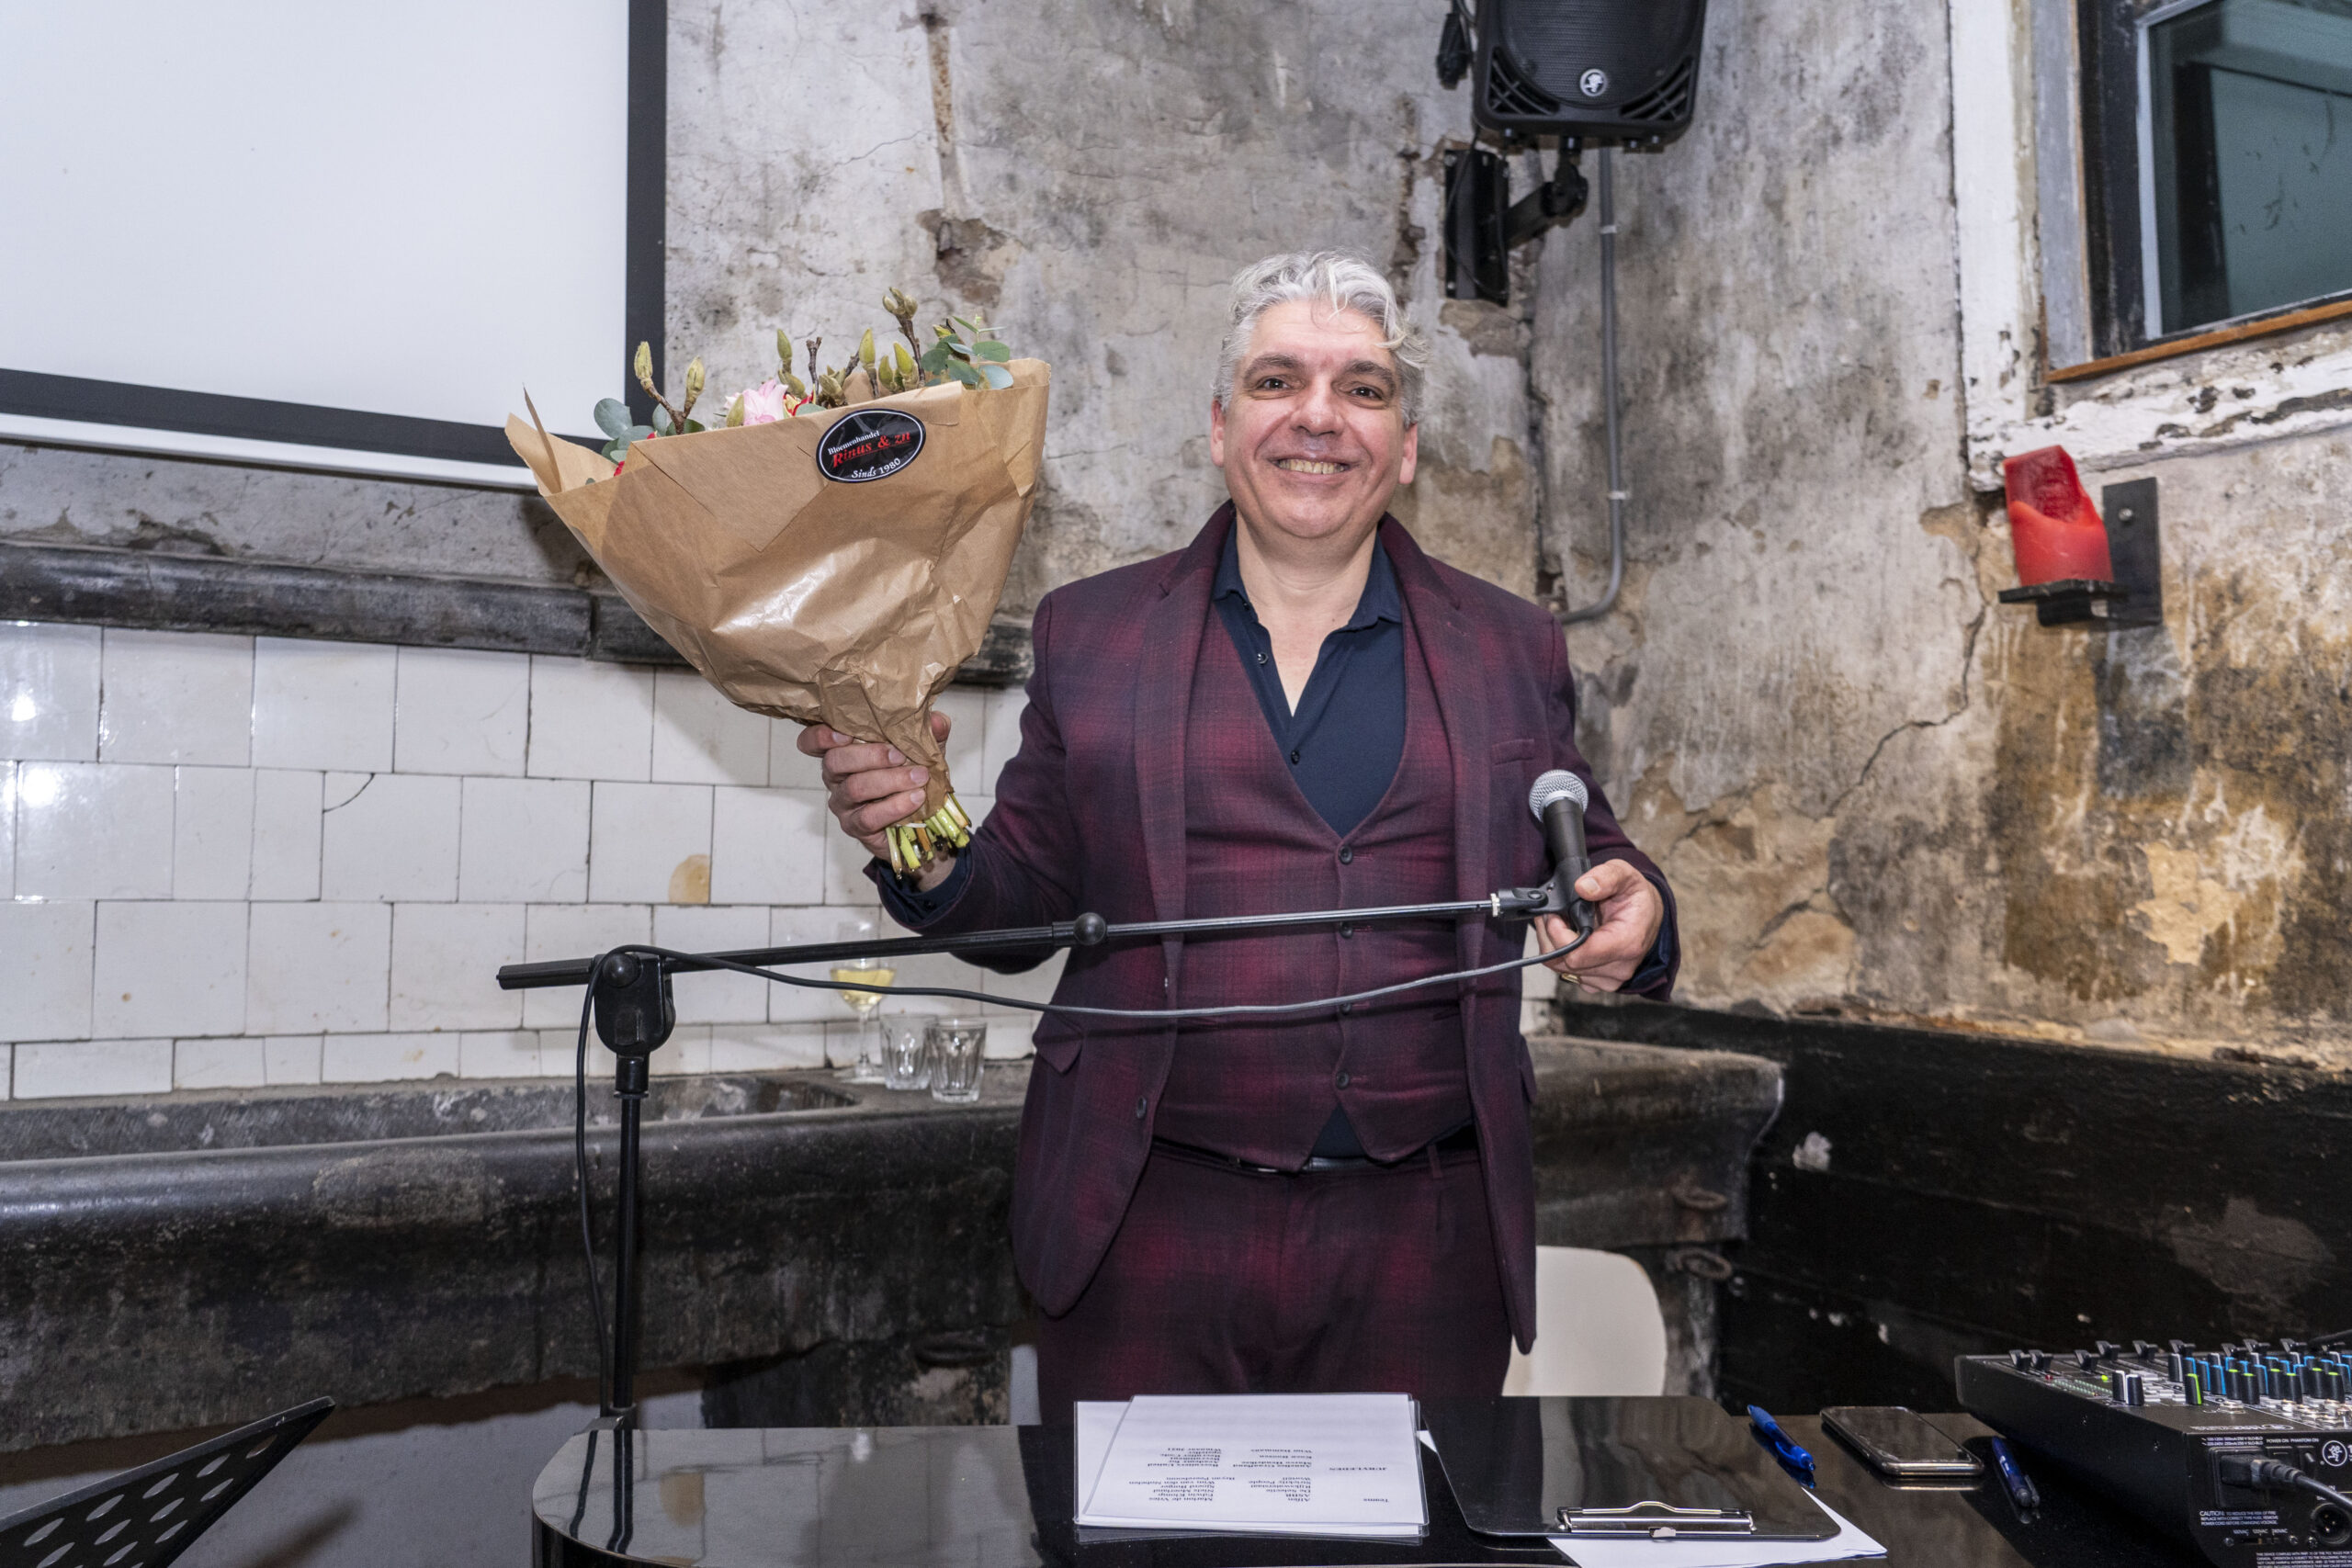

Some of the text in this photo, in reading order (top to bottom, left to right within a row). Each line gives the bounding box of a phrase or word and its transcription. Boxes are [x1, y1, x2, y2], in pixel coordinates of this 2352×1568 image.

[828, 430, 880, 456] Bloemenhandel
[832, 432, 910, 468] Rinus & zn
[851, 457, 900, 479] Sinds 1980
